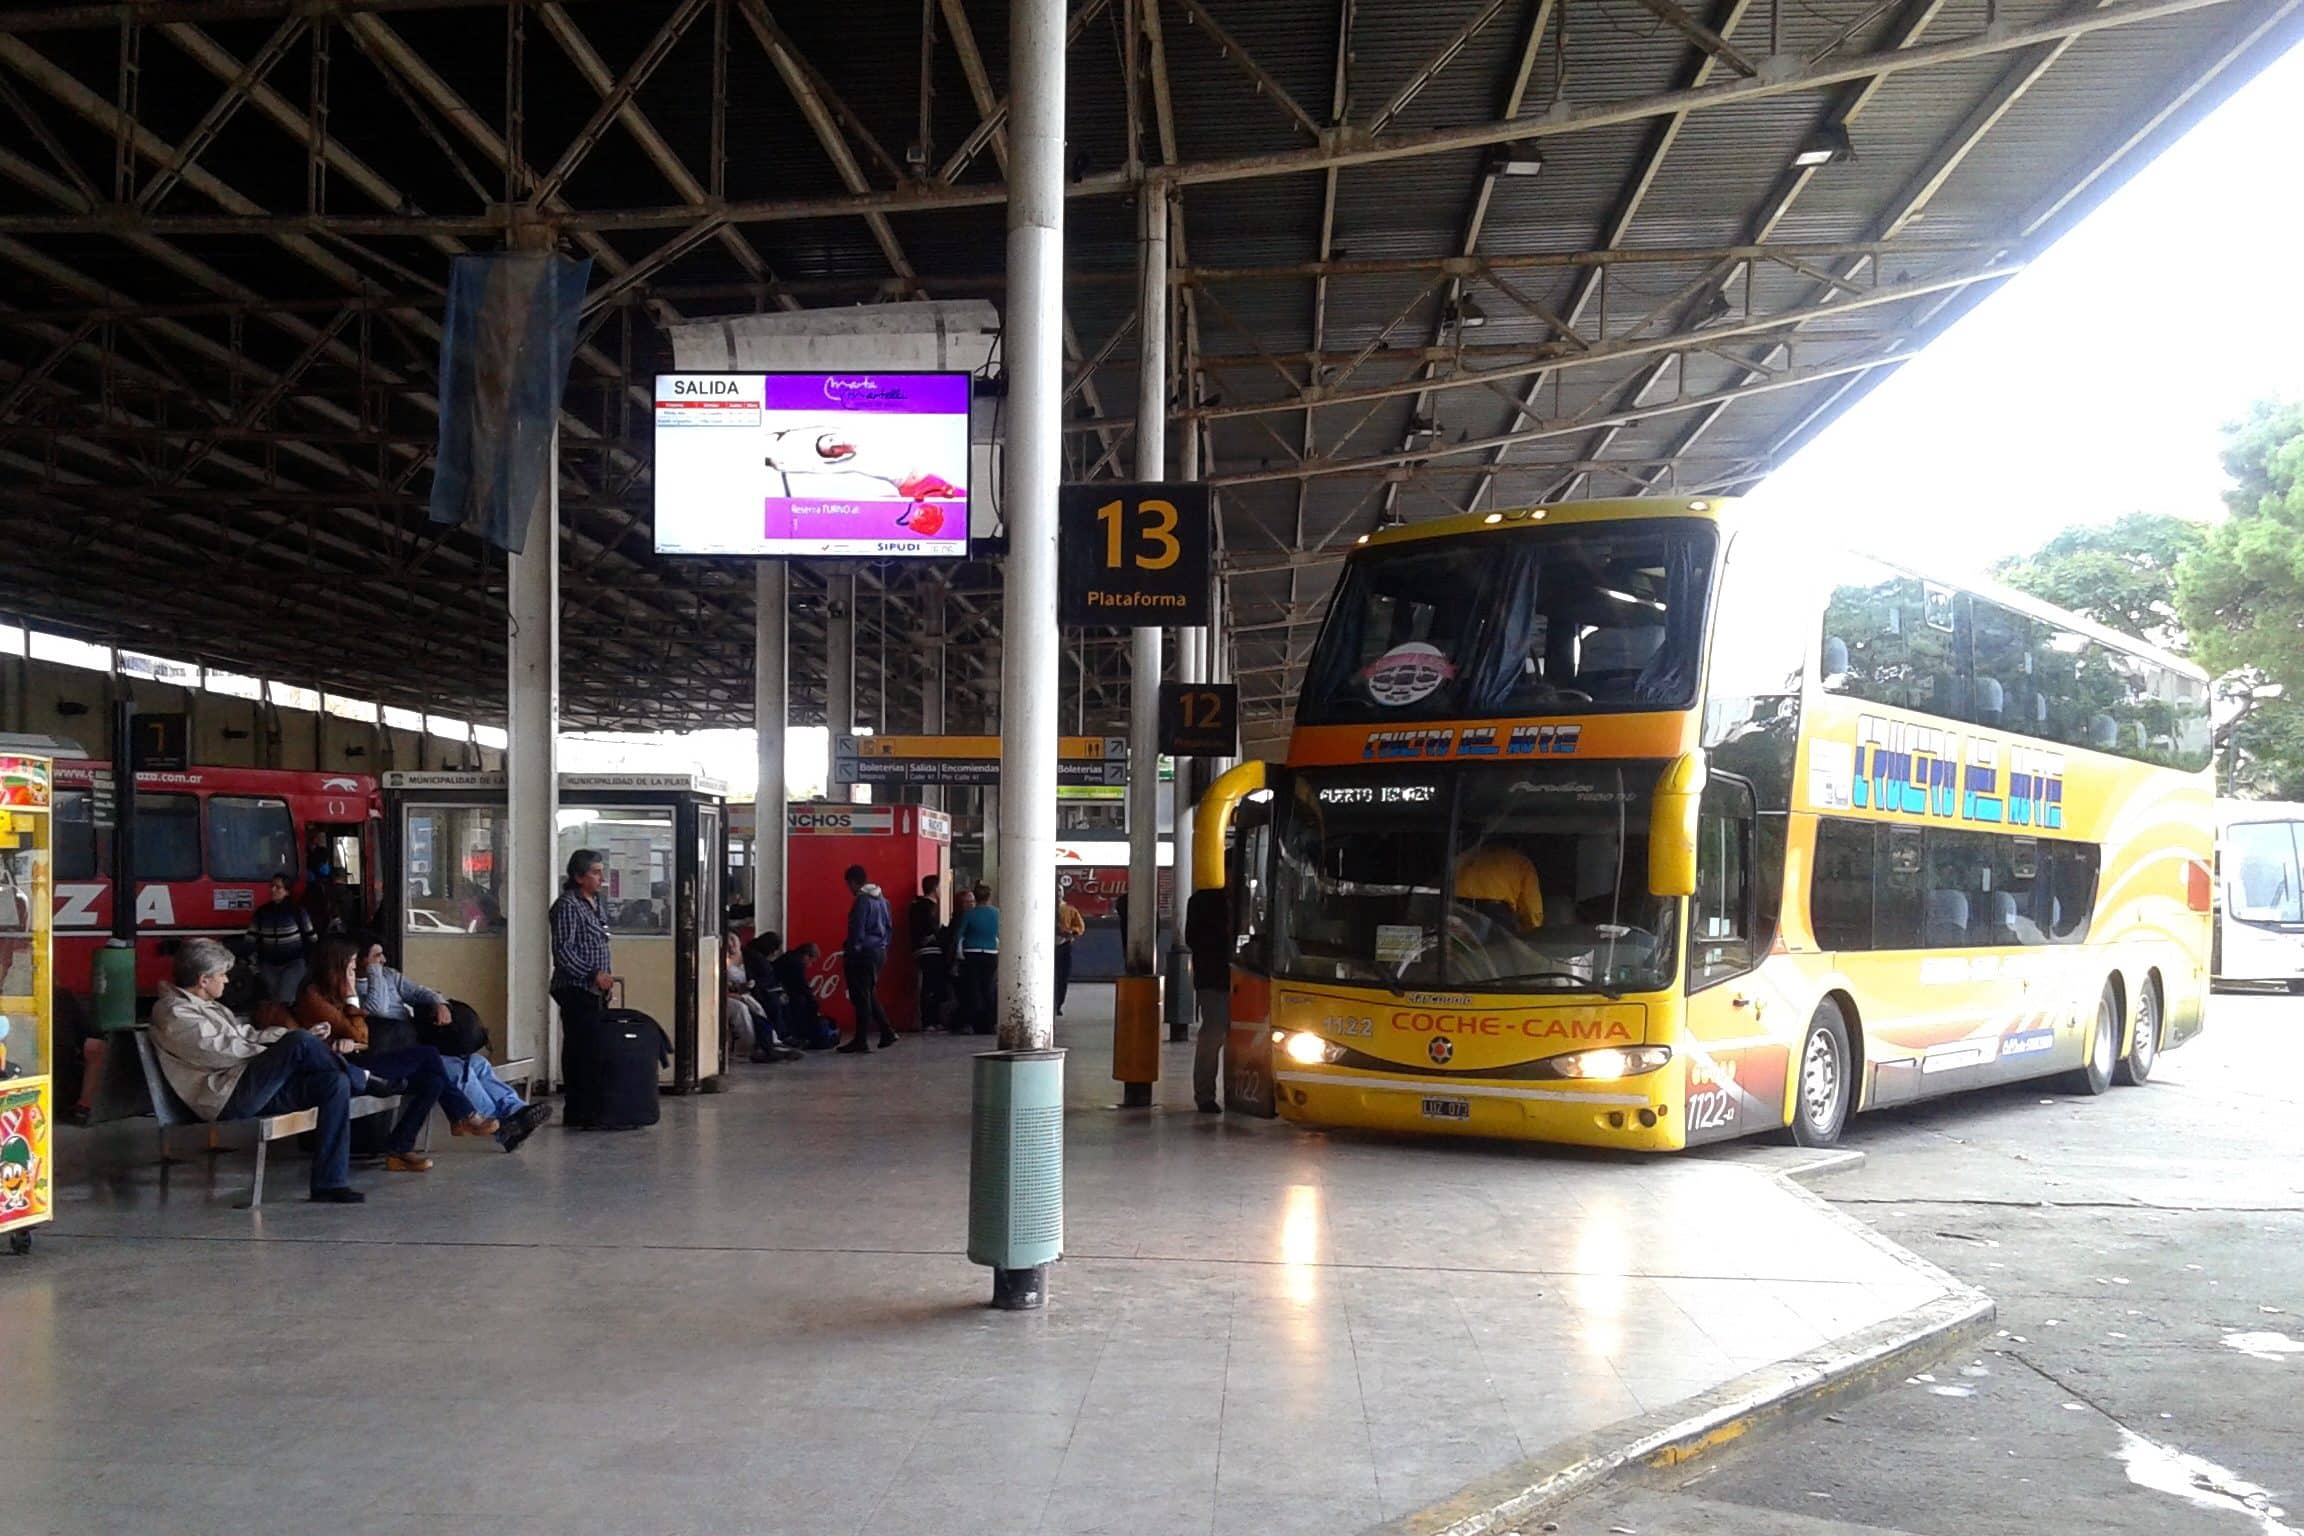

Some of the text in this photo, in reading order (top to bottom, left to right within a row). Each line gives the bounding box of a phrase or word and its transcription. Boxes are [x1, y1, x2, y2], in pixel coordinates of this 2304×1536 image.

[674, 380, 739, 395] SALIDA
[1097, 499, 1181, 570] 13
[877, 542, 920, 551] SIPUDI
[1087, 591, 1187, 607] Plataforma
[1179, 691, 1222, 728] 12
[909, 763, 937, 772] Salida
[942, 763, 999, 773] Encomiendas
[408, 775, 477, 785] MUNICIPALIDAD
[480, 775, 491, 785] DE
[664, 778, 691, 786] PLATA
[788, 814, 852, 827] NCHOS
[1323, 1016, 1373, 1037] 1122
